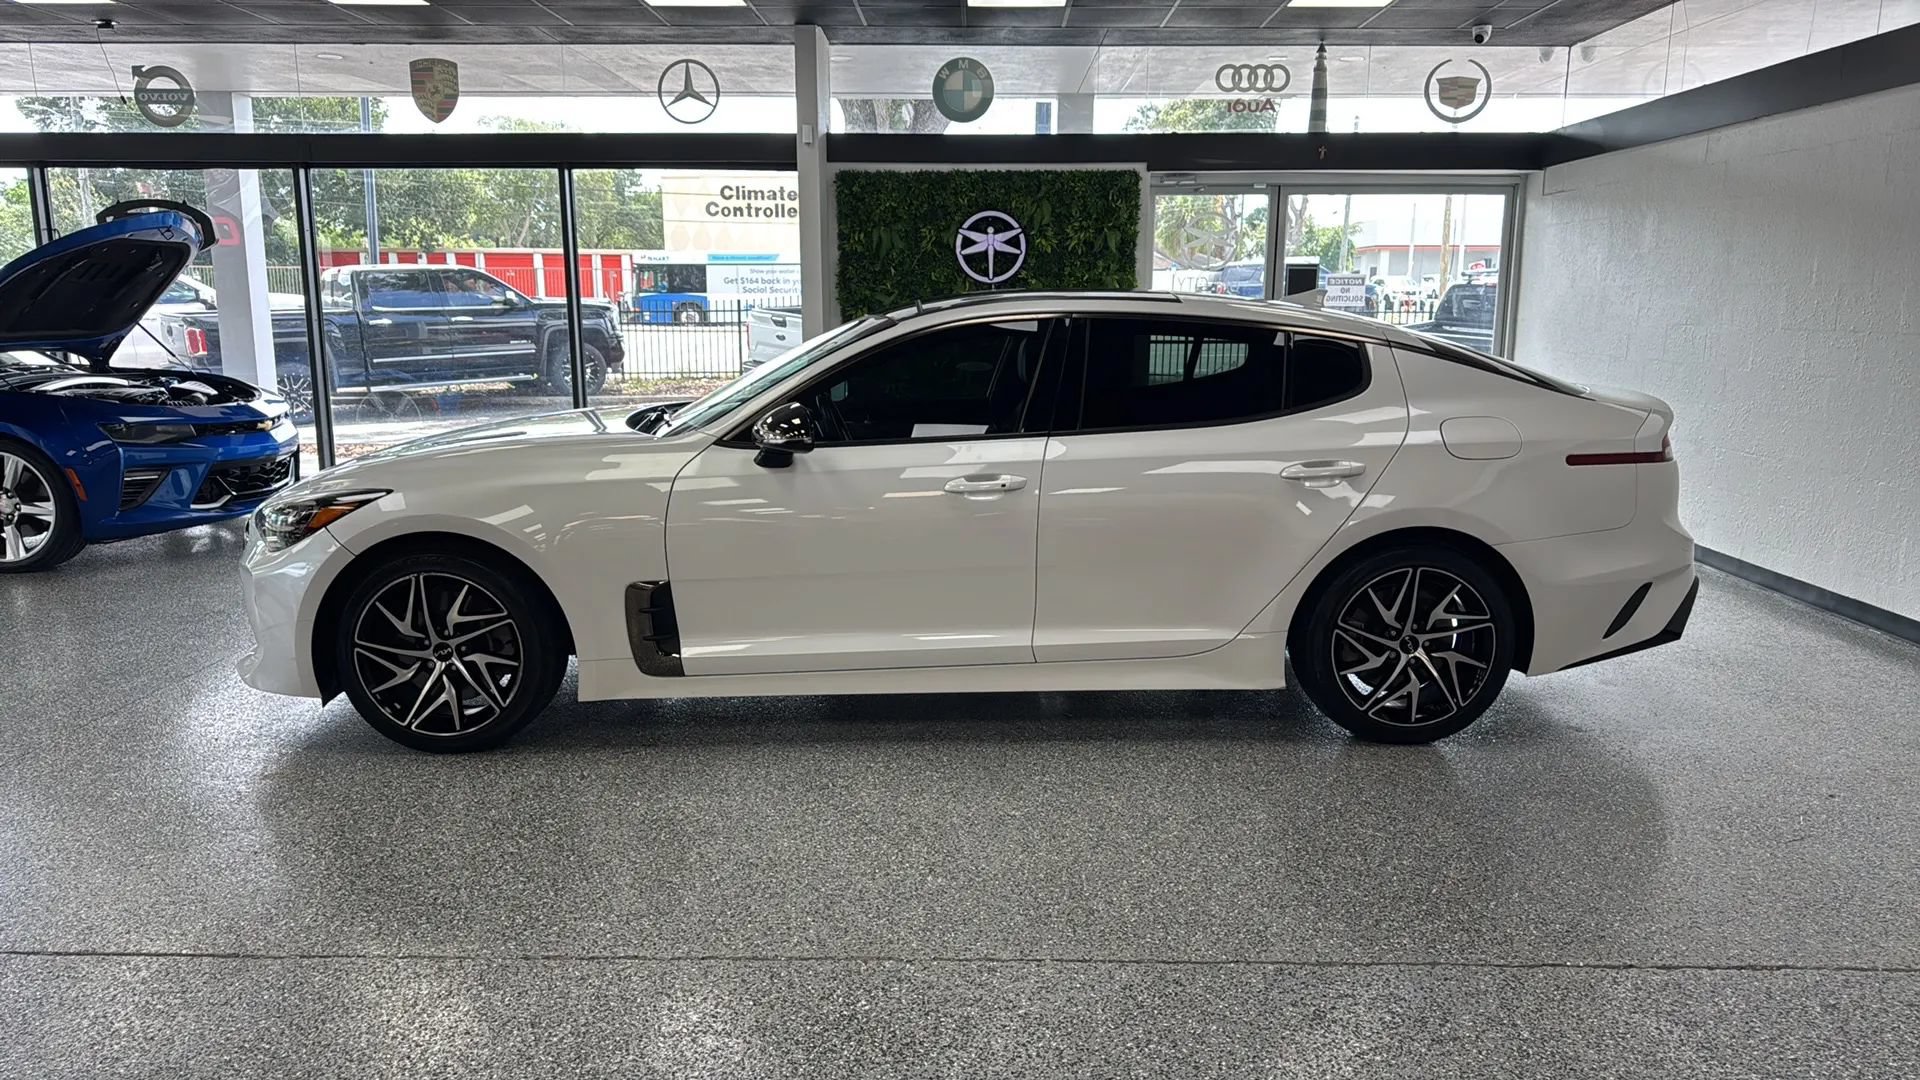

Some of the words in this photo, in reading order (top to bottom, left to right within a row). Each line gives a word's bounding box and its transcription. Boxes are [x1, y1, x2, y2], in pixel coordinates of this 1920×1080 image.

[719, 185, 798, 201] Climate
[723, 277, 739, 285] Get
[740, 277, 760, 285] $164
[760, 276, 781, 285] back
[782, 277, 791, 285] in
[742, 286, 768, 294] Social
